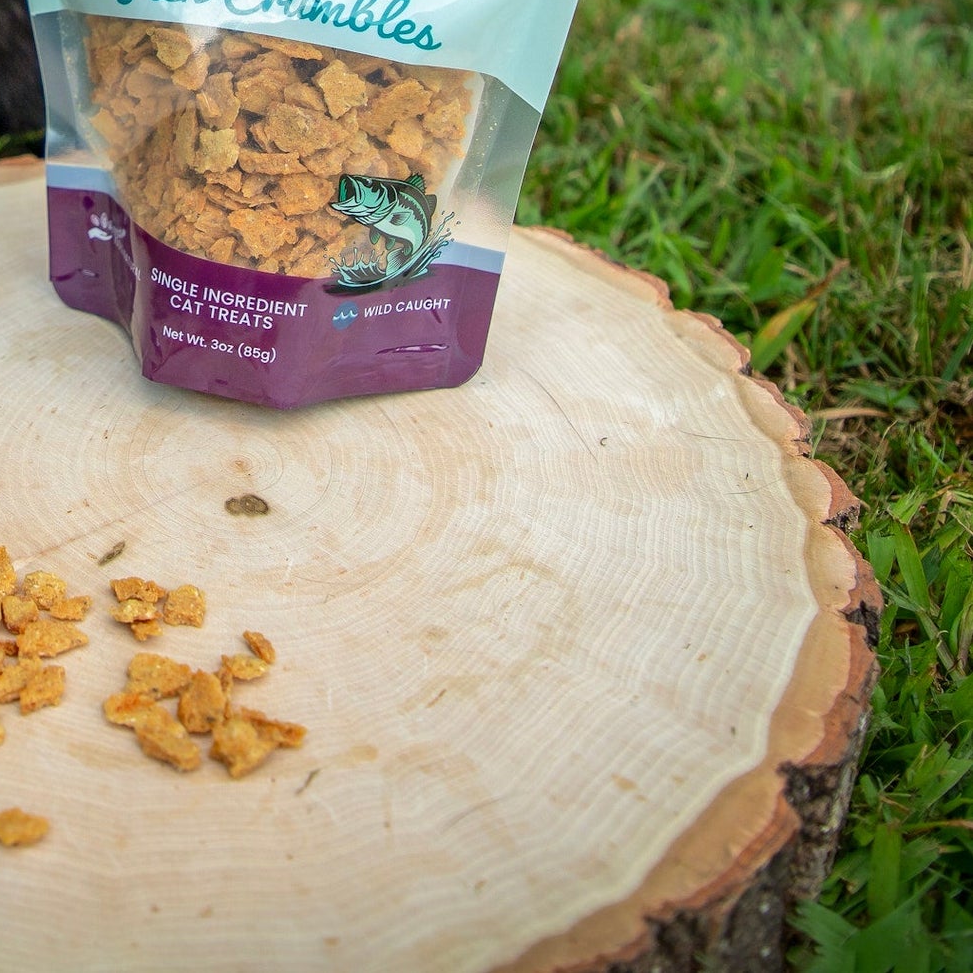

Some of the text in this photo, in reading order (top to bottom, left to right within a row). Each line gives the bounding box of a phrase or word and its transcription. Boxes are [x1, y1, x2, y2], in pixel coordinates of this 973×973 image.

[150, 267, 308, 317] SINGLE INGREDIENT
[363, 298, 451, 319] WILD CAUGHT
[169, 294, 274, 330] CAT TREATS
[162, 325, 277, 364] Net Wt. 3oz (85g)
